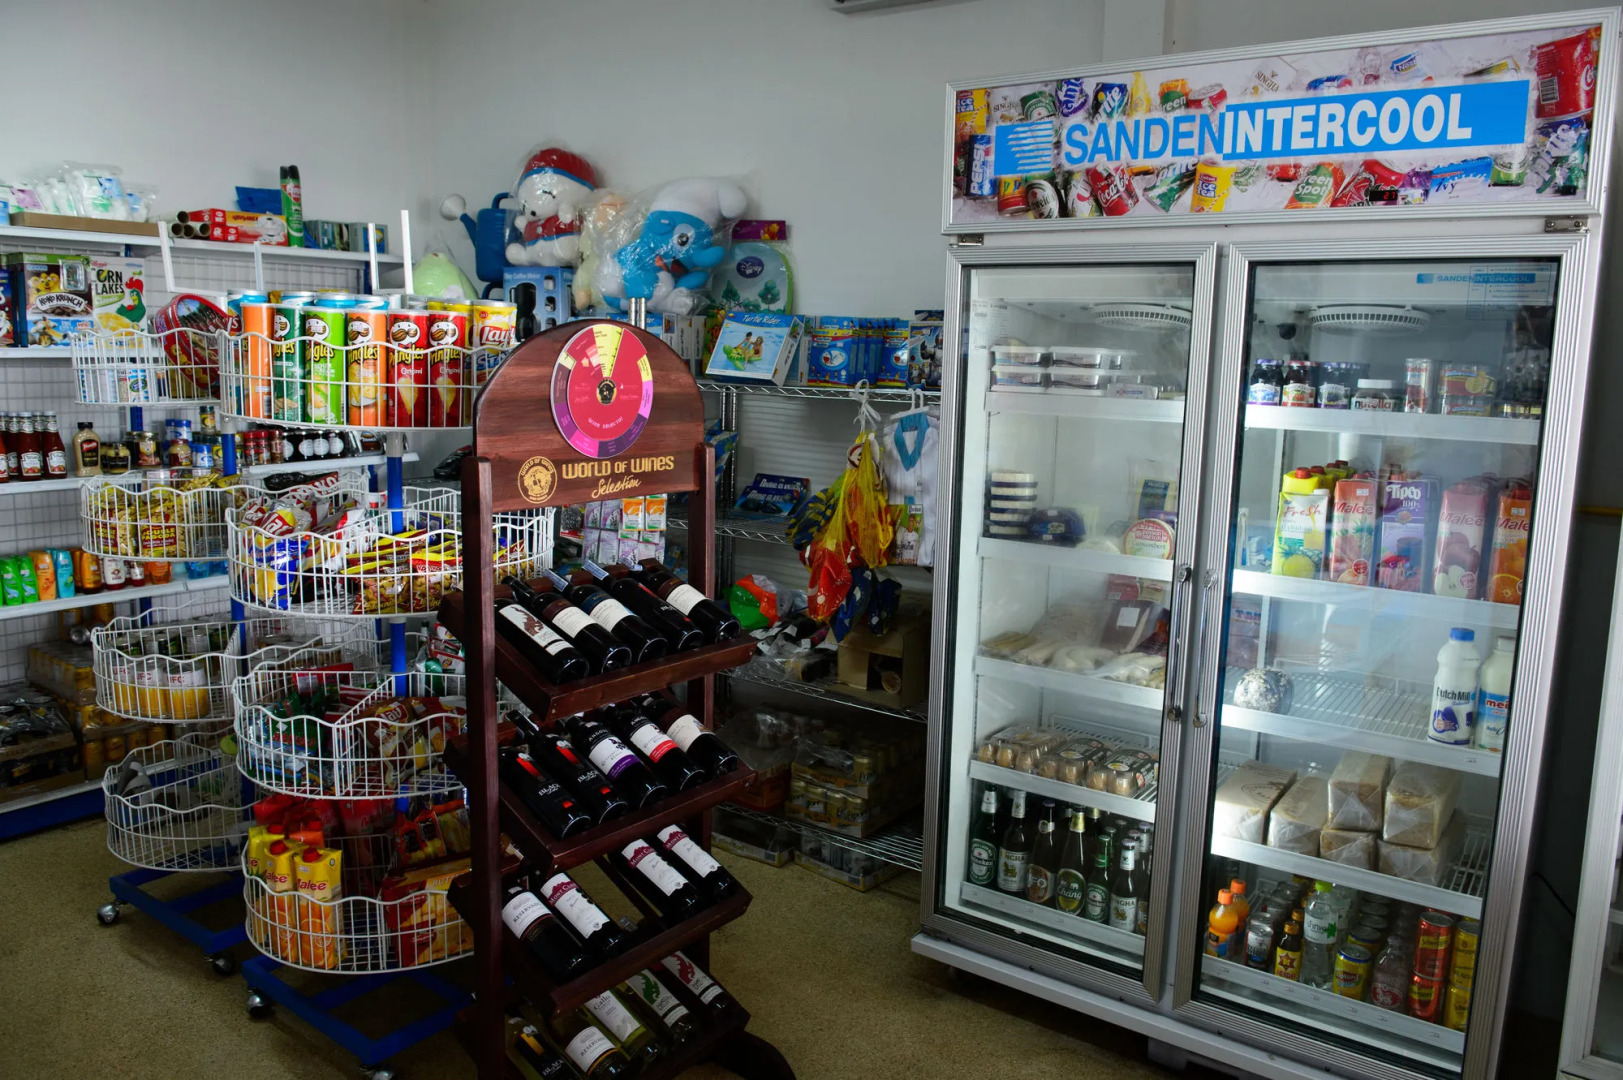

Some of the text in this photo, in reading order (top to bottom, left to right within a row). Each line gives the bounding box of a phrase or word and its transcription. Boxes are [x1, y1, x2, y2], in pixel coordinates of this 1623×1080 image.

[1397, 59, 1418, 71] Nest
[1162, 95, 1187, 111] reen
[1064, 93, 1472, 166] SANDEN INTERCOOL
[1303, 174, 1333, 186] reen
[1435, 177, 1457, 194] Ivy
[1383, 191, 1397, 200] 27
[96, 269, 123, 283] ORN
[95, 282, 125, 295] LAKES
[38, 291, 84, 308] KOKO KRUNCH
[742, 314, 781, 326] Turtle Rider
[1355, 398, 1391, 409] nutella
[561, 456, 675, 479] WORLD OF WINES
[591, 475, 642, 499] Selection
[1385, 484, 1422, 500] Tipco
[1283, 503, 1323, 518] Fresh
[1334, 501, 1374, 515] Malee
[1440, 512, 1485, 526] Malee
[1497, 516, 1530, 531] Male
[1486, 699, 1509, 709] mei
[1056, 885, 1083, 900] Chang
